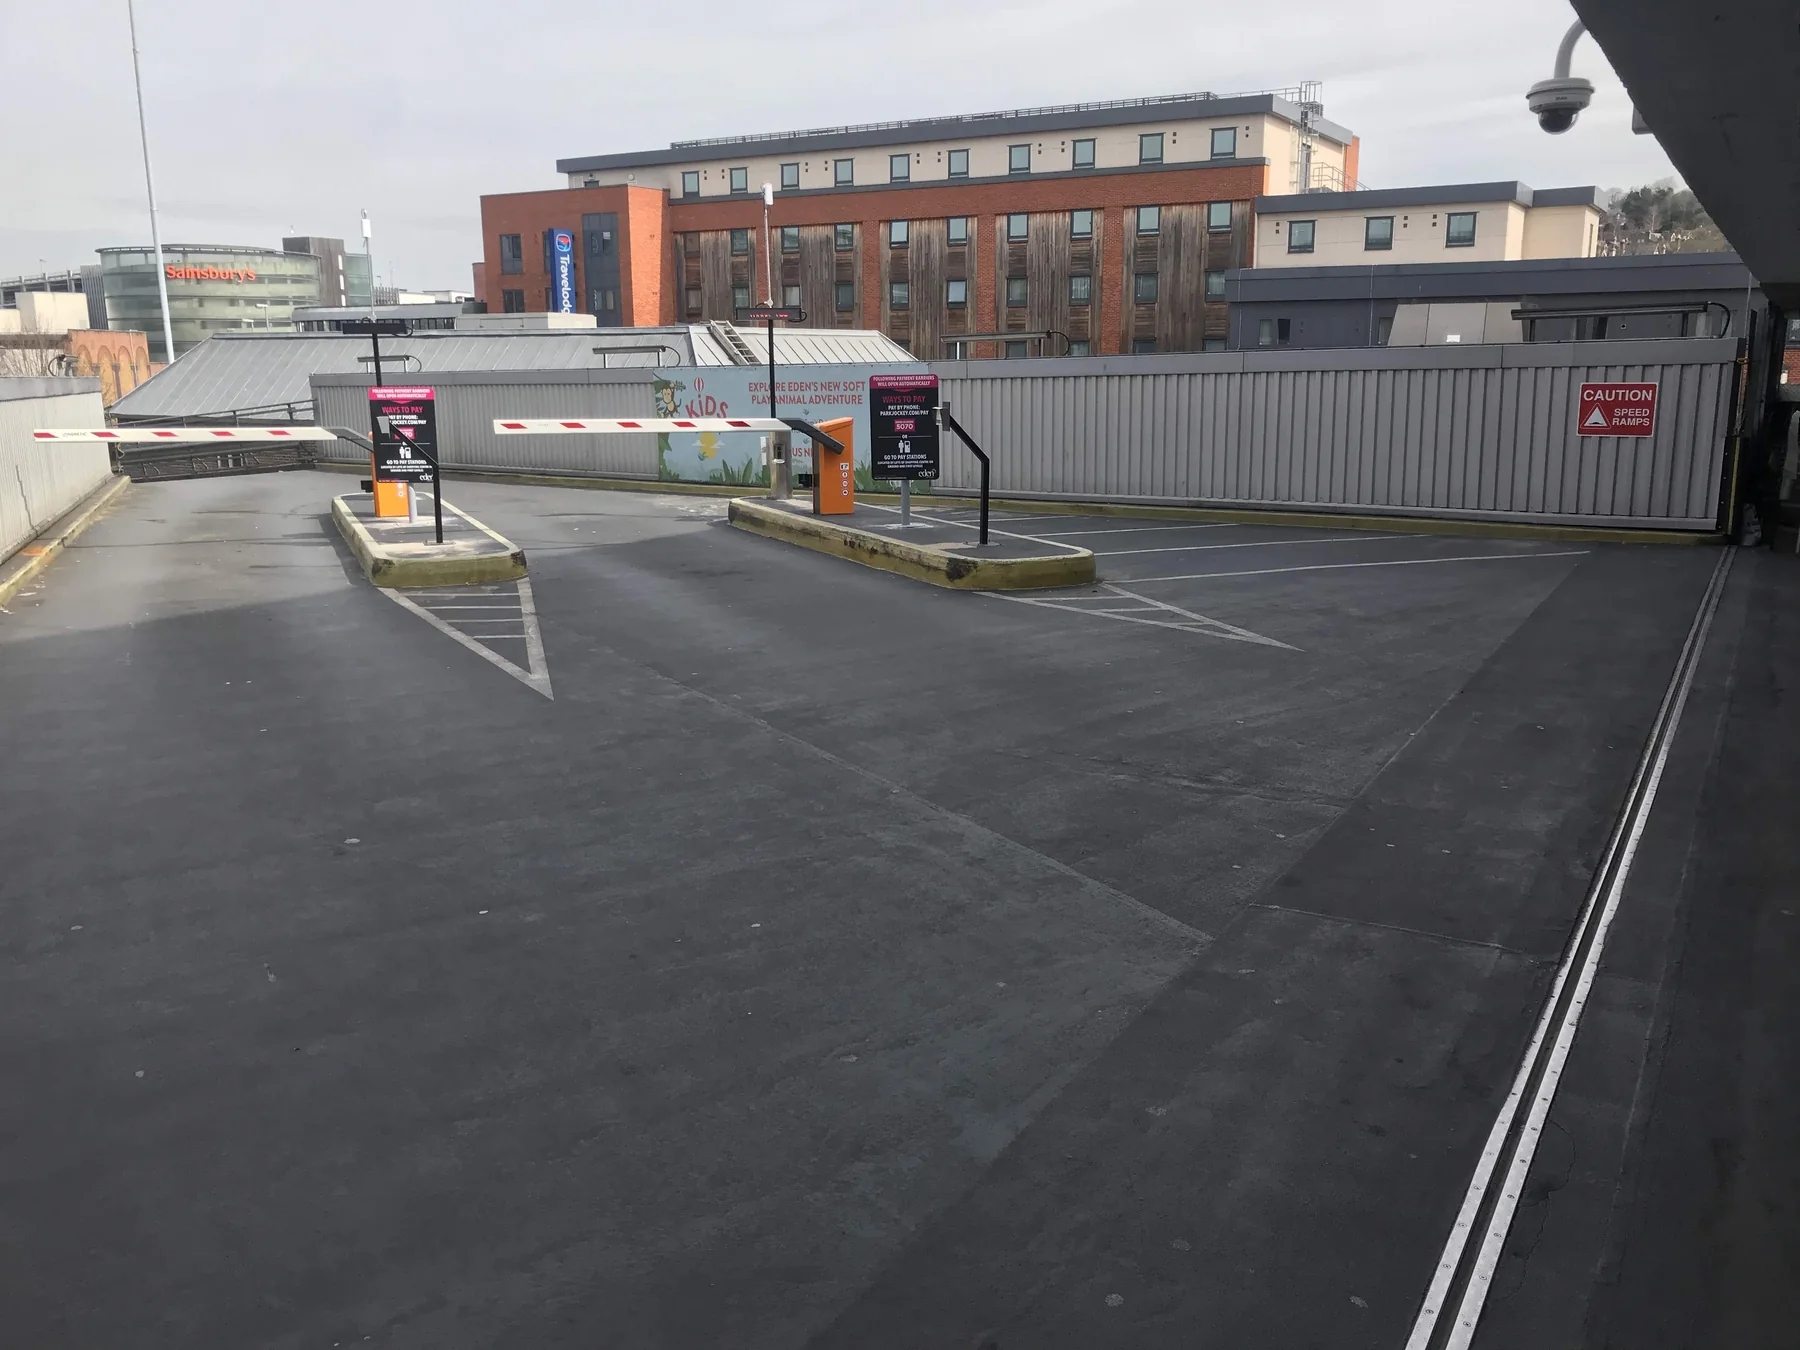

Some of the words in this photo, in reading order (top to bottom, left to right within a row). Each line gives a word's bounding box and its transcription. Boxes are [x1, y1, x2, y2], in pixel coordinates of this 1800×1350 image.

[166, 265, 256, 283] Sainsbury's
[560, 254, 572, 314] Travelodg
[749, 382, 785, 392] EXPLRE
[788, 382, 818, 391] EDEN'S
[821, 382, 841, 391] NEW
[843, 381, 866, 391] SOFT
[752, 395, 772, 404] PLAY
[774, 395, 807, 404] ANIMAL
[809, 395, 862, 404] ADVENTURE
[1583, 390, 1652, 401] CAUTION
[1614, 408, 1650, 416] SPEED
[1612, 418, 1650, 426] RAMPS
[918, 469, 936, 477] eden
